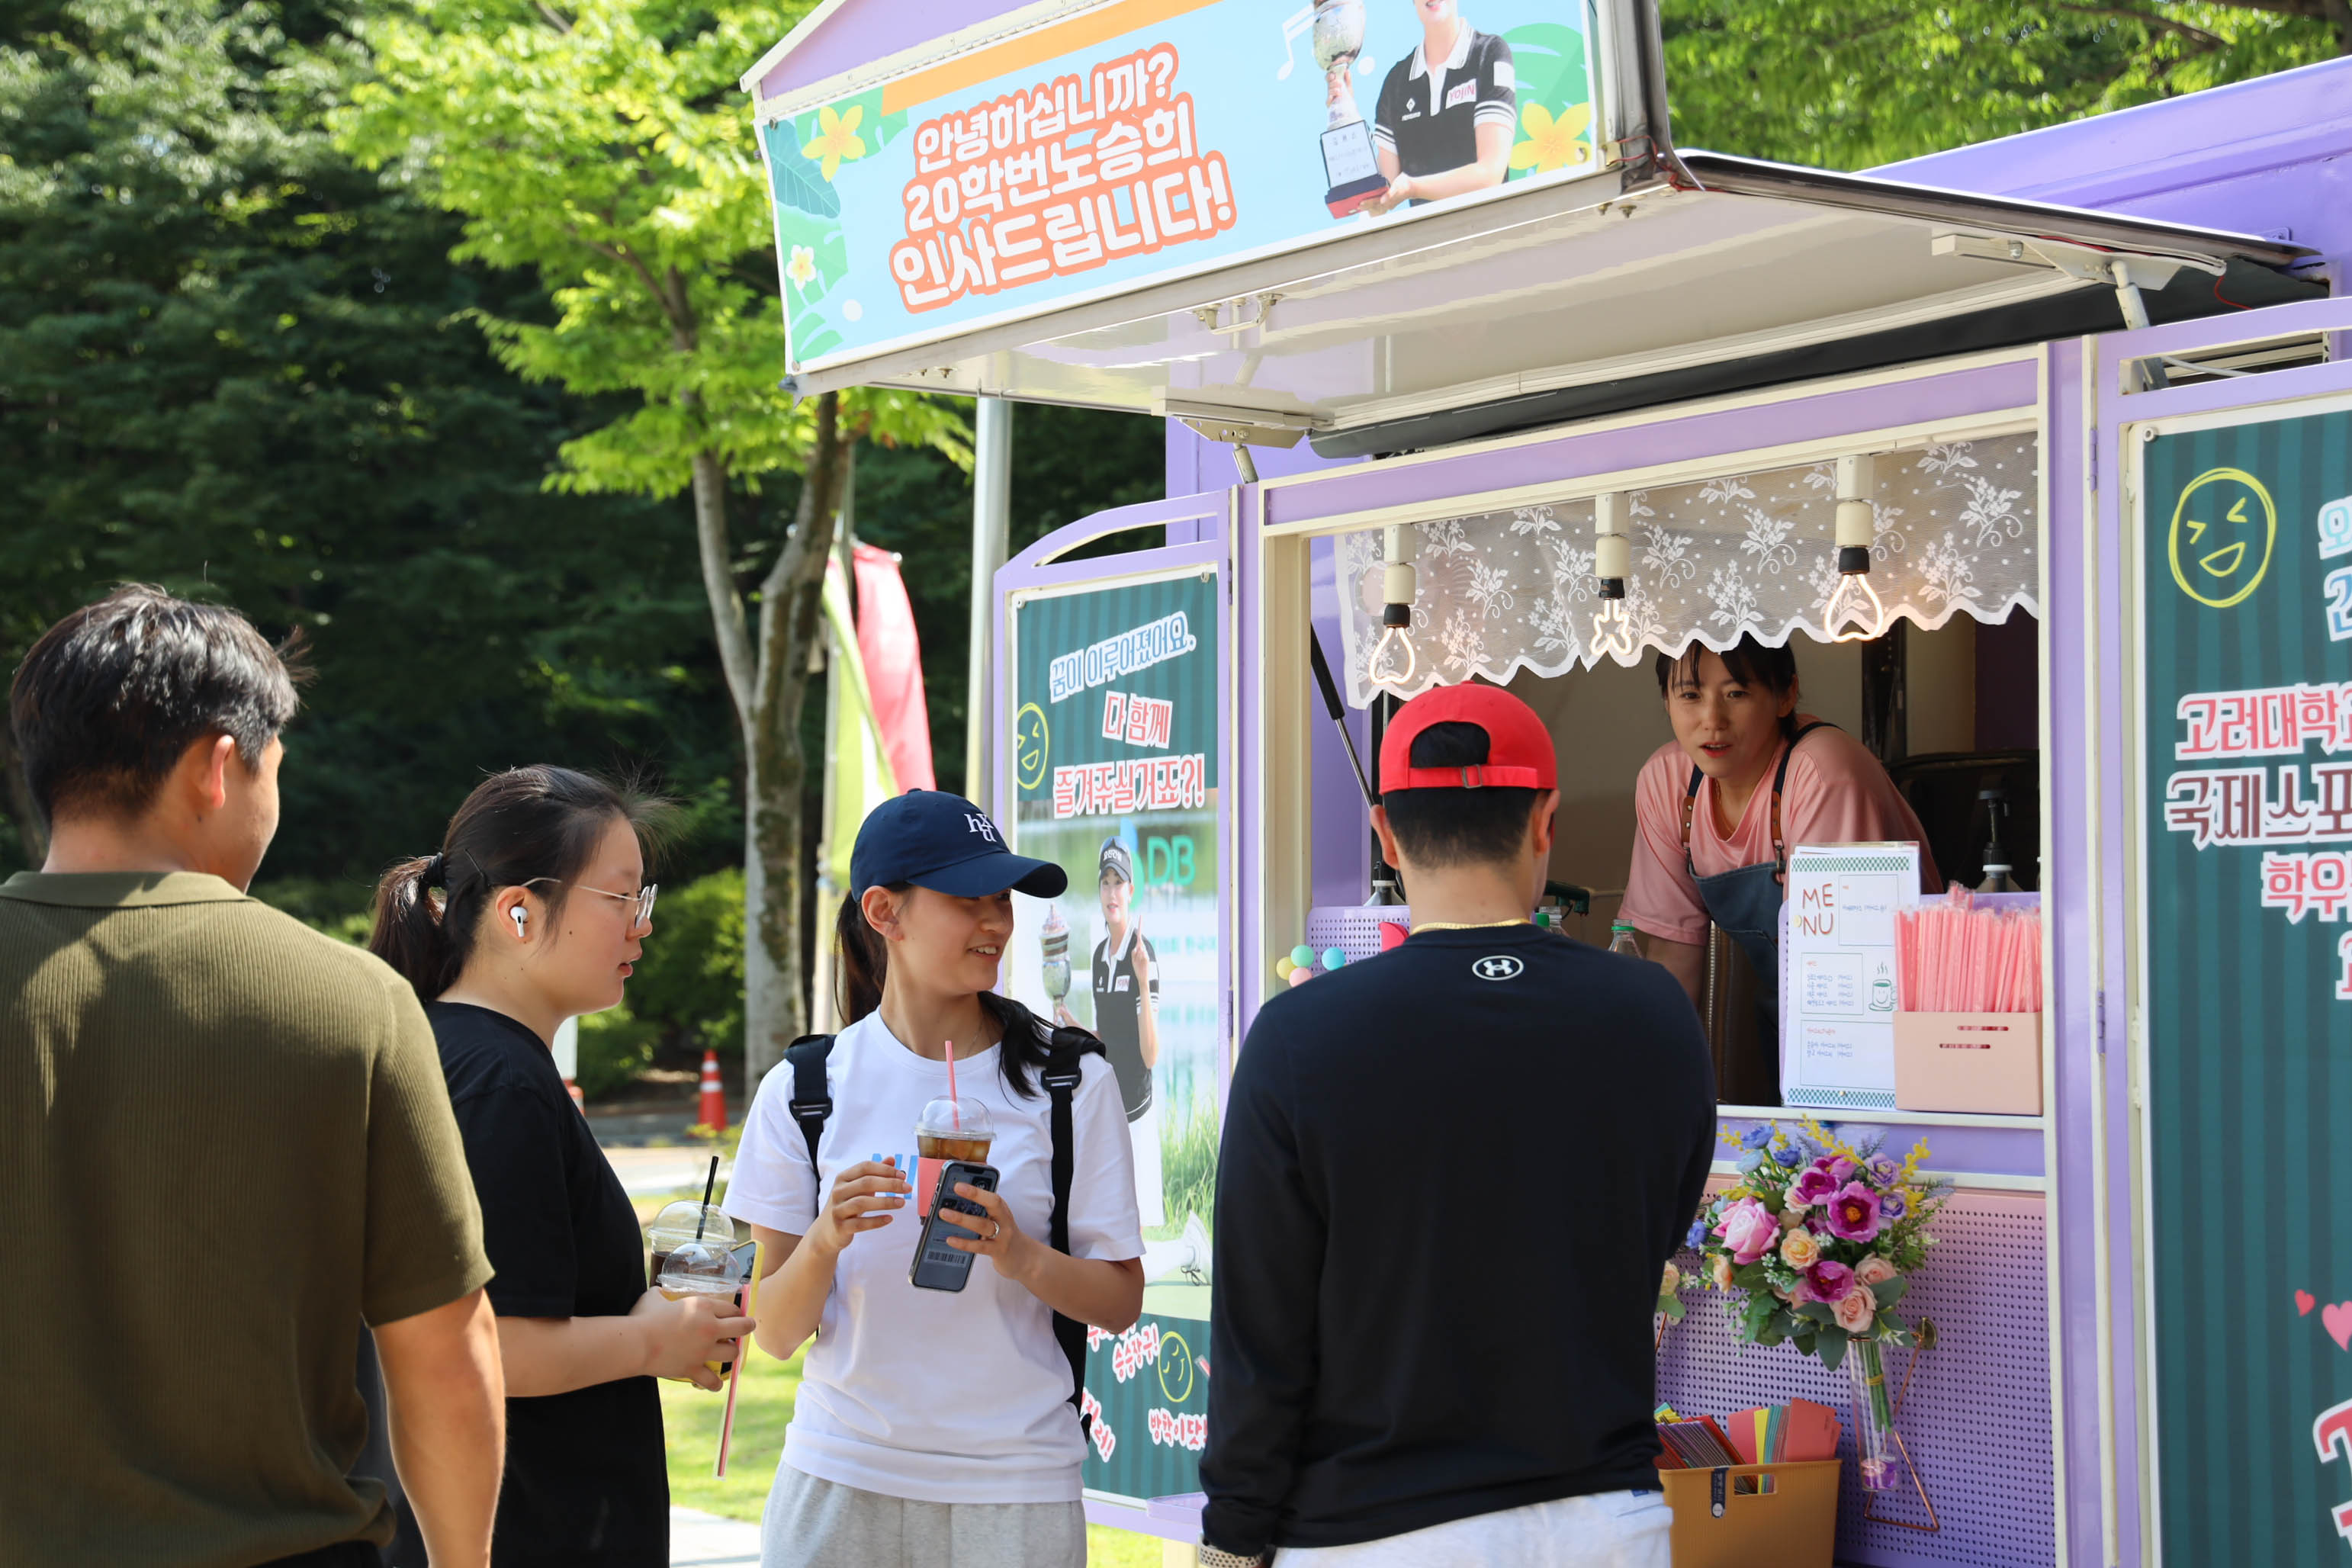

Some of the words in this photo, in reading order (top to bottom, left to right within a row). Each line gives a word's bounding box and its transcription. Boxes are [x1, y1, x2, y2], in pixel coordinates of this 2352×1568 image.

[917, 51, 1174, 174] 안녕하십니까?
[1449, 83, 1476, 101] YOJIN
[892, 159, 1230, 300] 인사드립니다!
[1052, 657, 1082, 698] 꿈이
[1088, 615, 1195, 683] 이루어졌어요.
[2180, 689, 2352, 753] 고려대학
[1147, 835, 1196, 885] DB
[2266, 859, 2352, 916] 학우
[1114, 1326, 1158, 1378] 승승장구!
